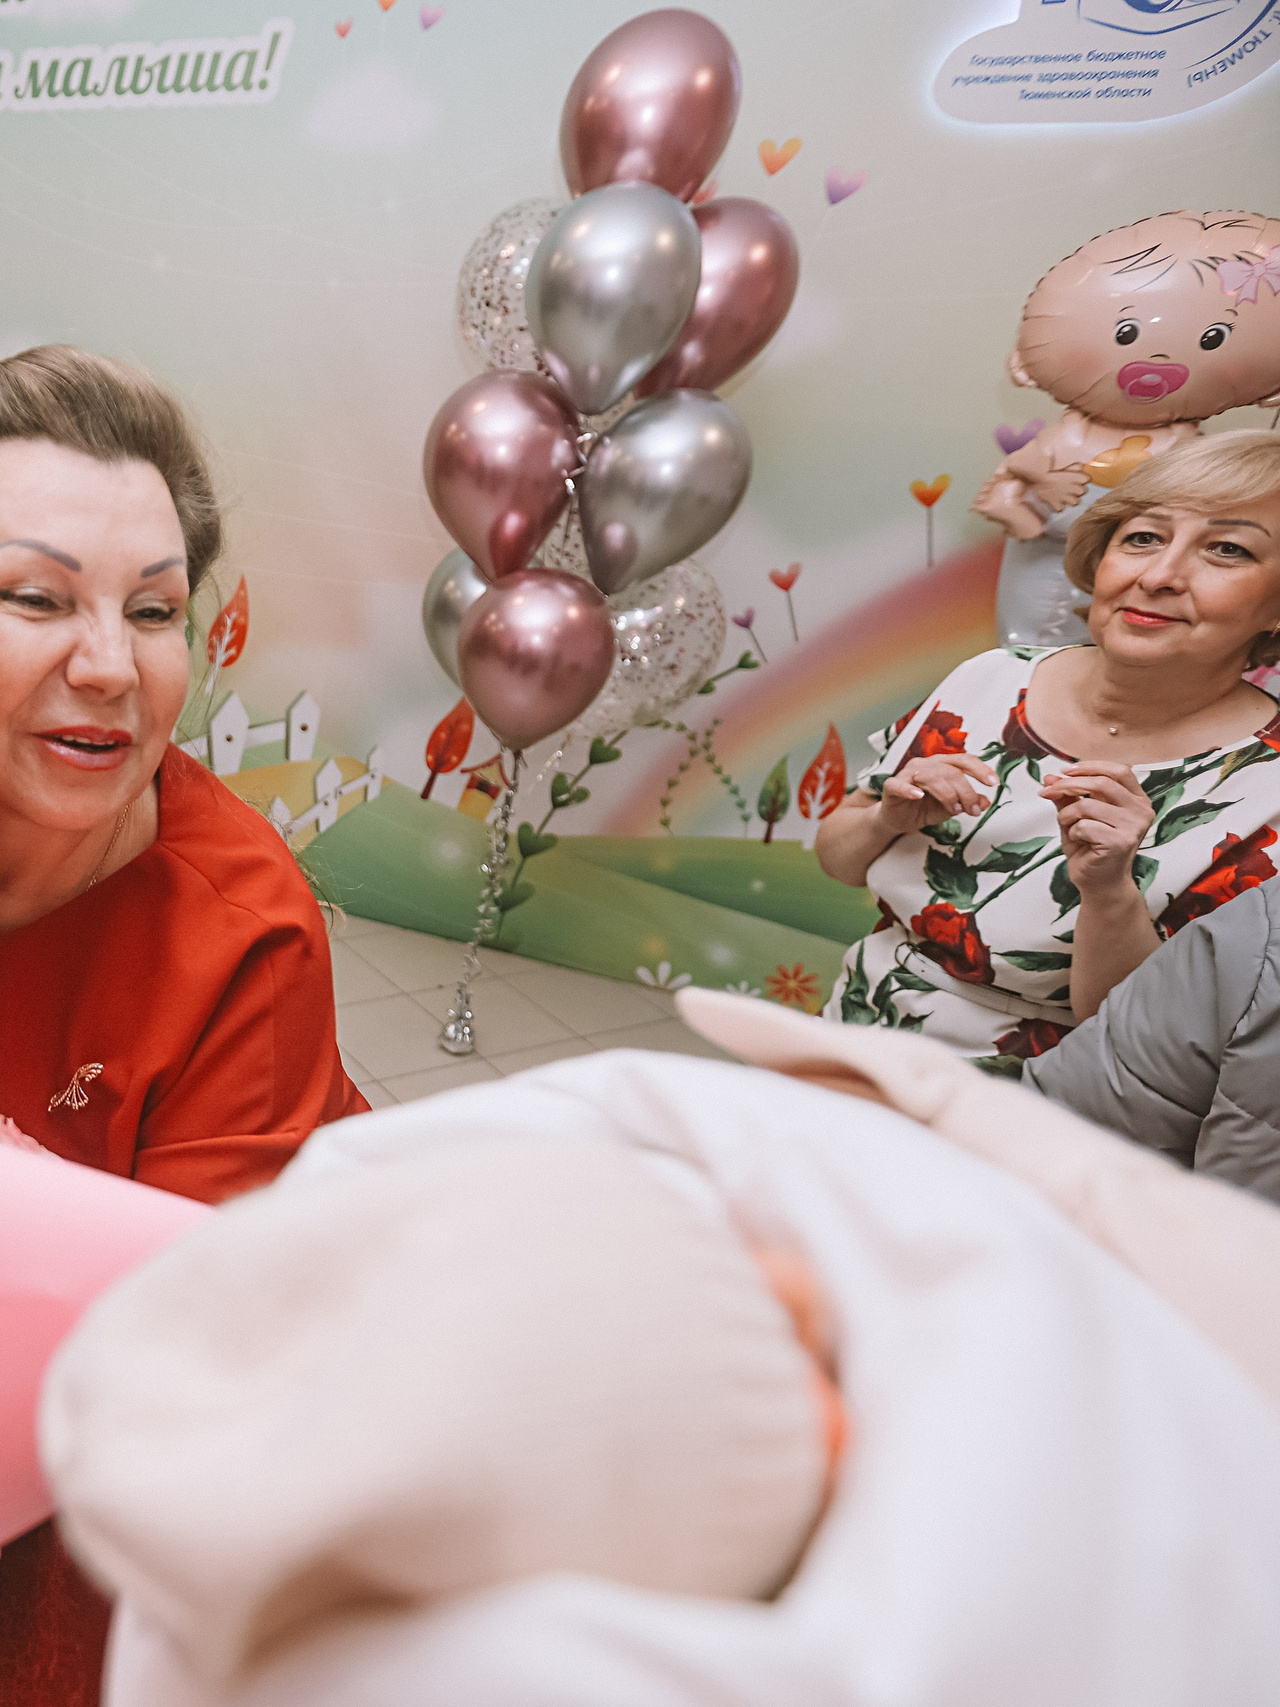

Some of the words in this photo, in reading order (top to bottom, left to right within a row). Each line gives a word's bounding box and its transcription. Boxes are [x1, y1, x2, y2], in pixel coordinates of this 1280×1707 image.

[15, 31, 283, 100] малыша!
[970, 51, 1082, 68] Государственное
[1086, 48, 1167, 63] бюджетное
[1037, 67, 1160, 84] здравоохранения
[1019, 87, 1092, 101] Тюменской
[1095, 85, 1153, 99] области
